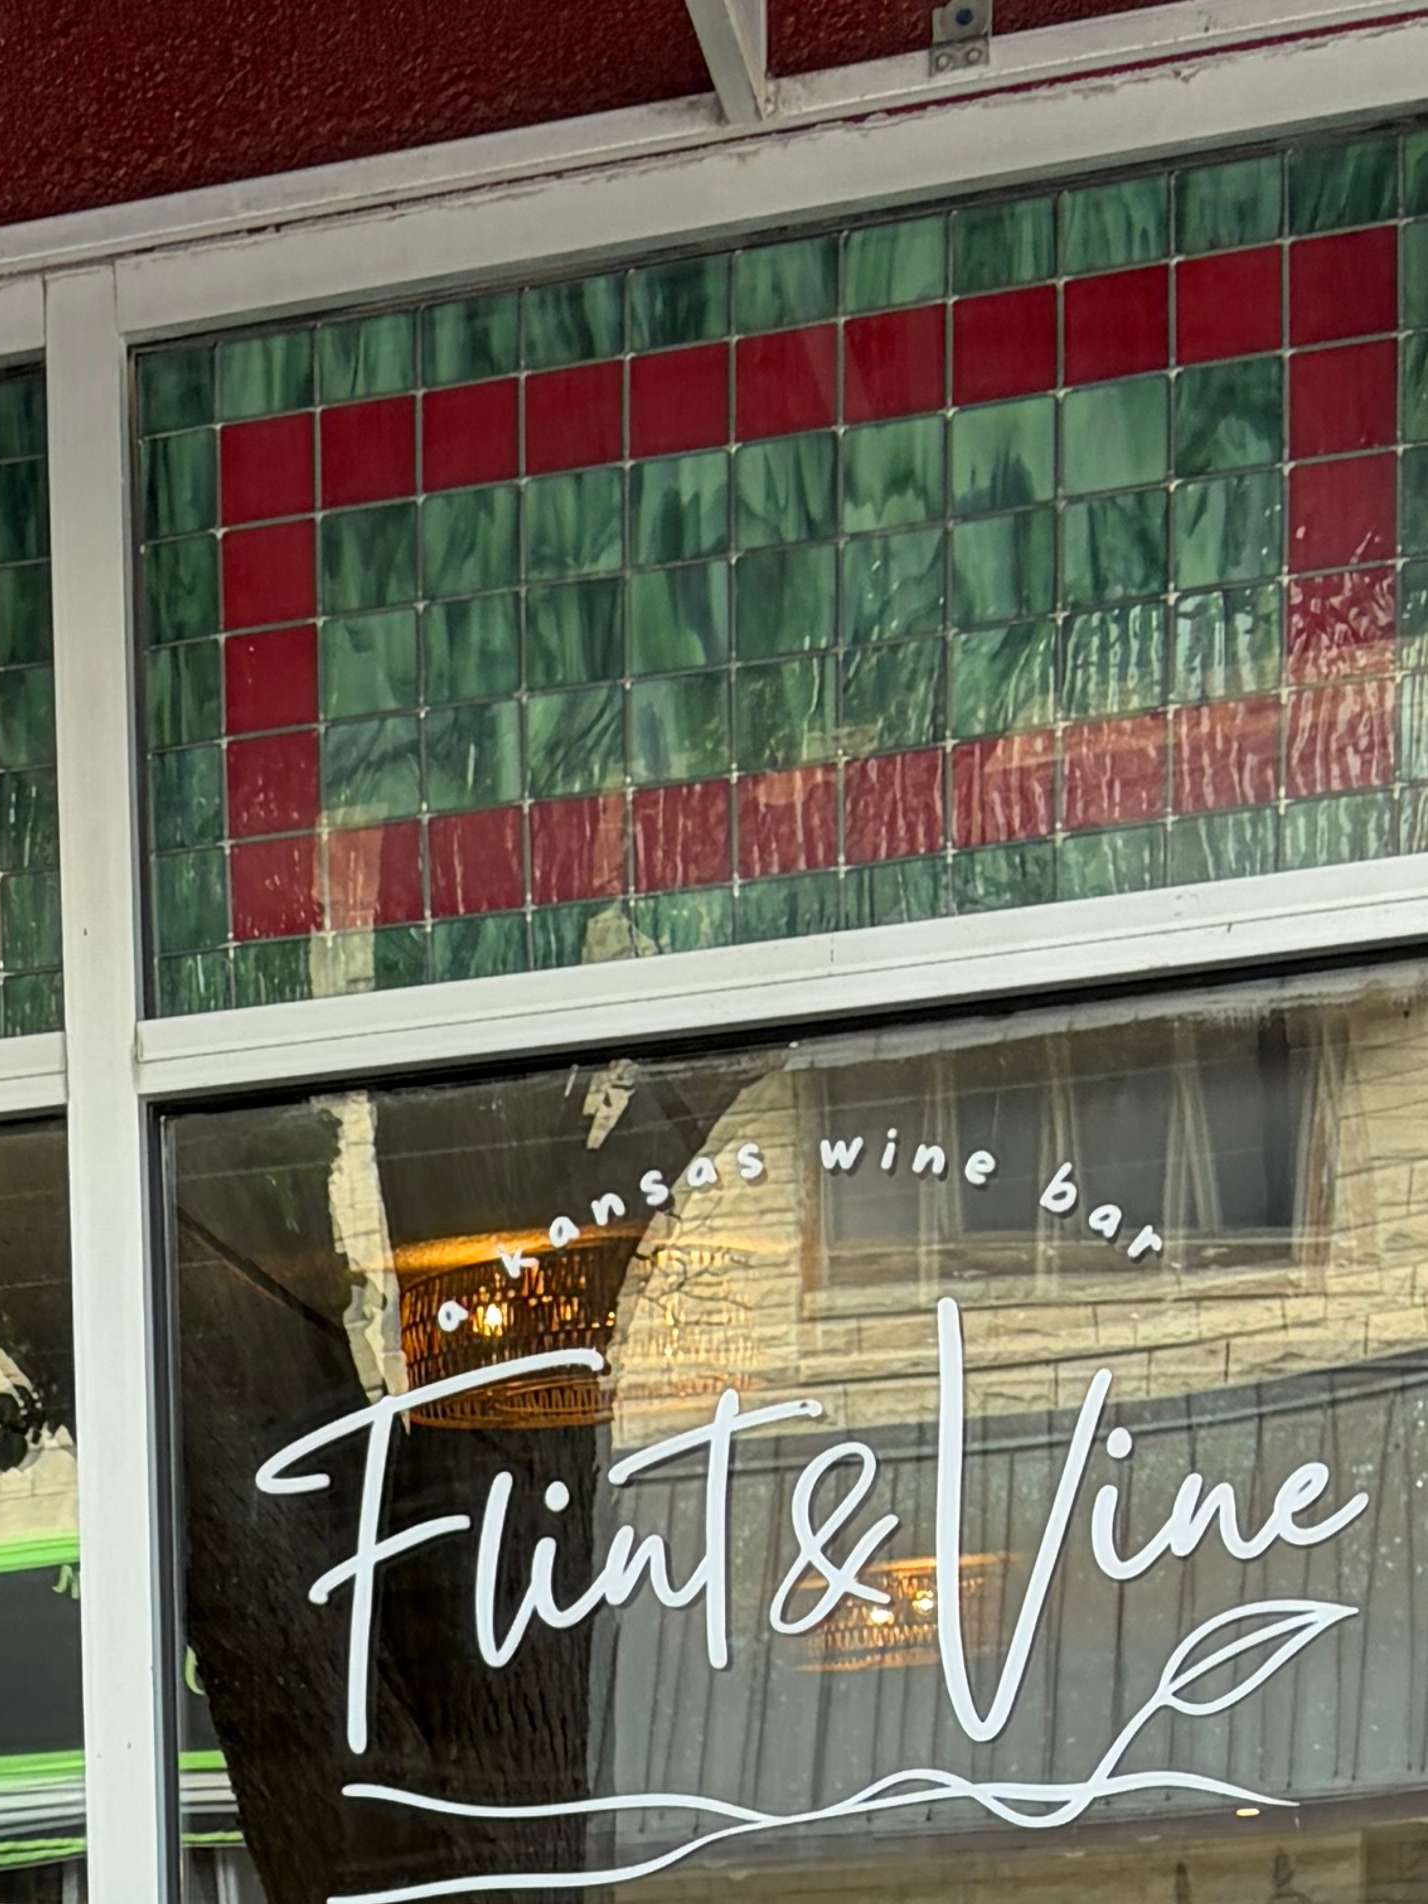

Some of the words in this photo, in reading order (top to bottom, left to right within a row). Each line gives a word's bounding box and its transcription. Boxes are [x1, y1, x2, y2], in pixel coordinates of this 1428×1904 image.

[437, 1300, 469, 1333] a
[498, 1141, 766, 1279] kansas
[819, 1128, 999, 1185] wine
[1040, 1161, 1165, 1262] bar
[254, 1346, 825, 1755] Flint
[767, 1441, 899, 1635] &
[936, 1296, 1370, 1743] Vine
